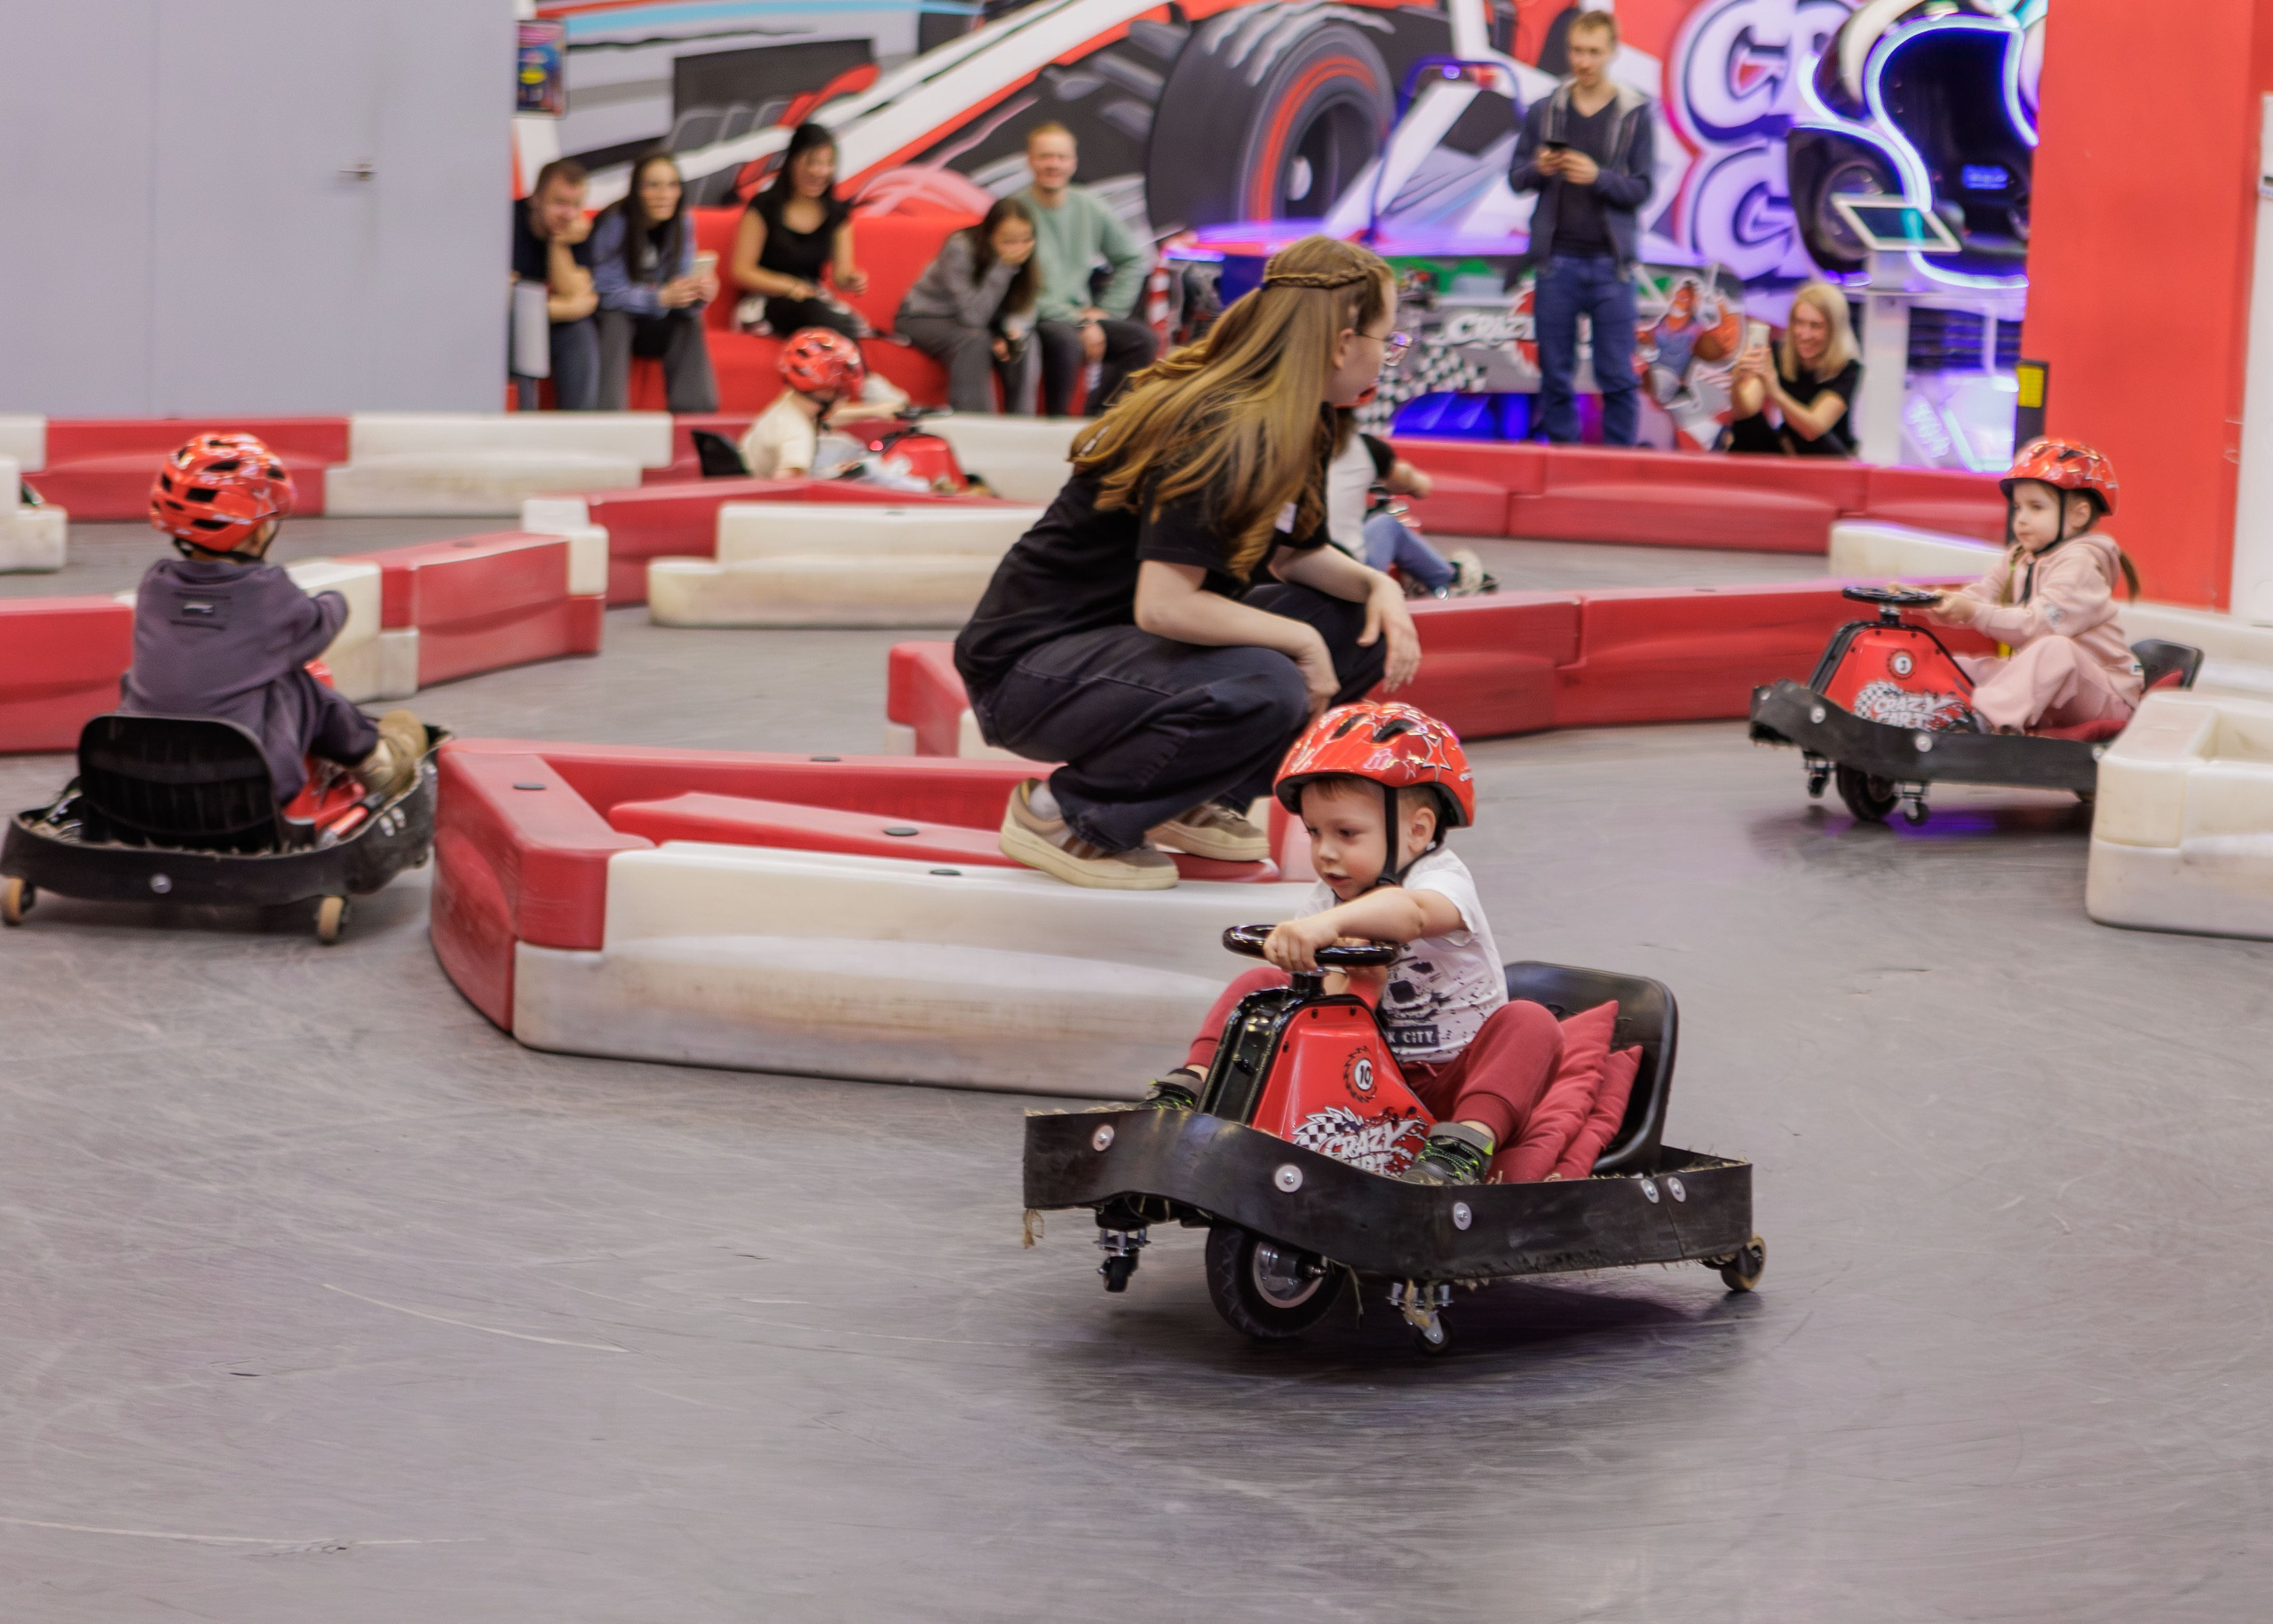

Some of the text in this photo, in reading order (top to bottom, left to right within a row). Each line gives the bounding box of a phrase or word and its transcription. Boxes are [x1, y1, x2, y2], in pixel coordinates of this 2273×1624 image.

[1873, 695, 1963, 714] CRAZY
[1401, 1030, 1435, 1044] CITY
[1359, 1065, 1372, 1085] 10
[1321, 1118, 1427, 1158] CRAZY
